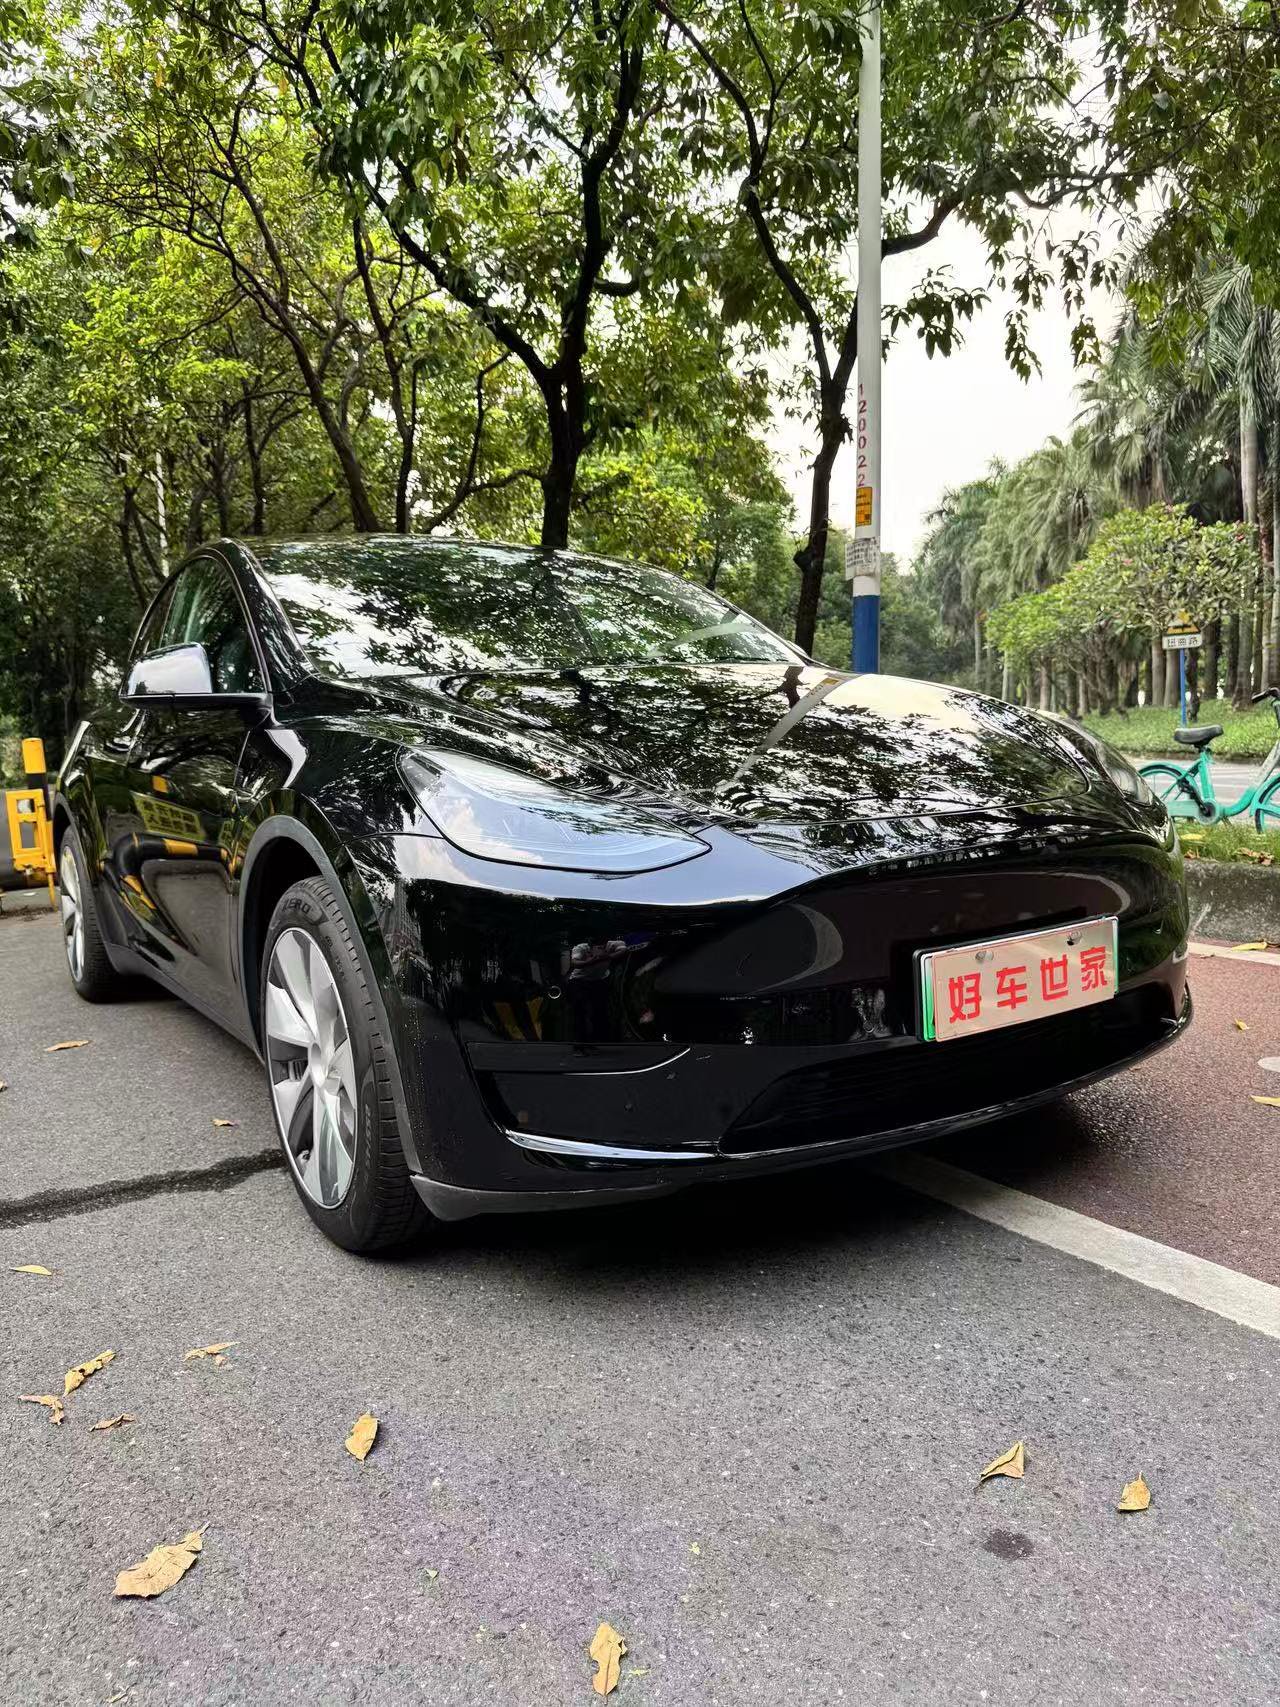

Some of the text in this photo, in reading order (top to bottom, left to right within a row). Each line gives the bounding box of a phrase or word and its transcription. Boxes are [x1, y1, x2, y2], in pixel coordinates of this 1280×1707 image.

[858, 384, 867, 487] 120022
[948, 946, 1107, 1024] 好车世家
